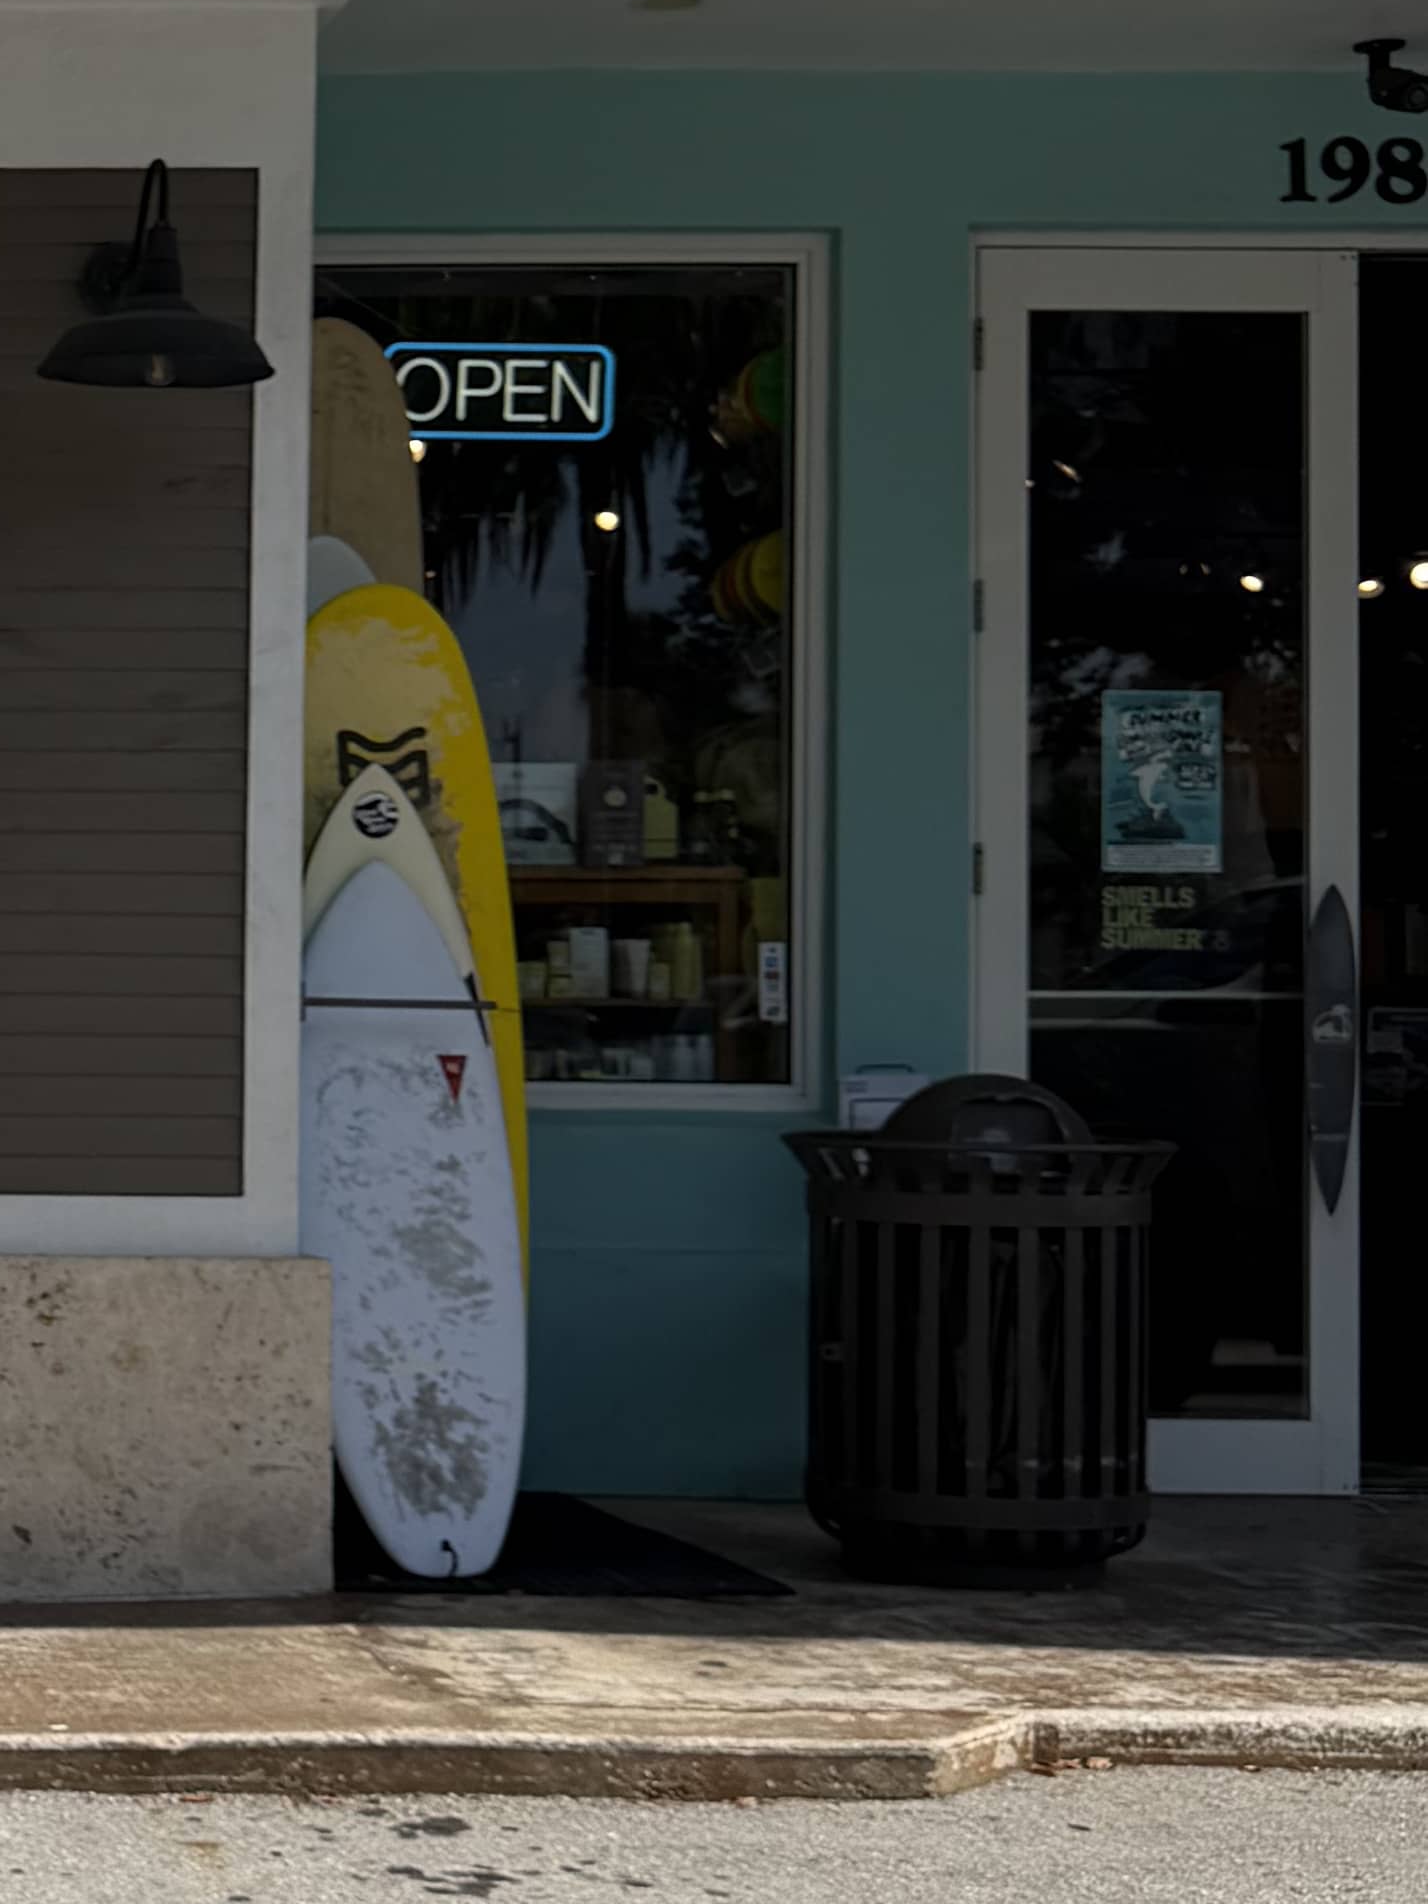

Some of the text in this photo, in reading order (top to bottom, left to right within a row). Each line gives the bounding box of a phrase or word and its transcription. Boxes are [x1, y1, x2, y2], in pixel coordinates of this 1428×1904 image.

[1279, 136, 1428, 203] 198
[396, 357, 602, 423] OPEN
[1101, 885, 1195, 908] SMELLS
[1101, 907, 1156, 928] LIKE
[1100, 928, 1205, 951] SUMMER
